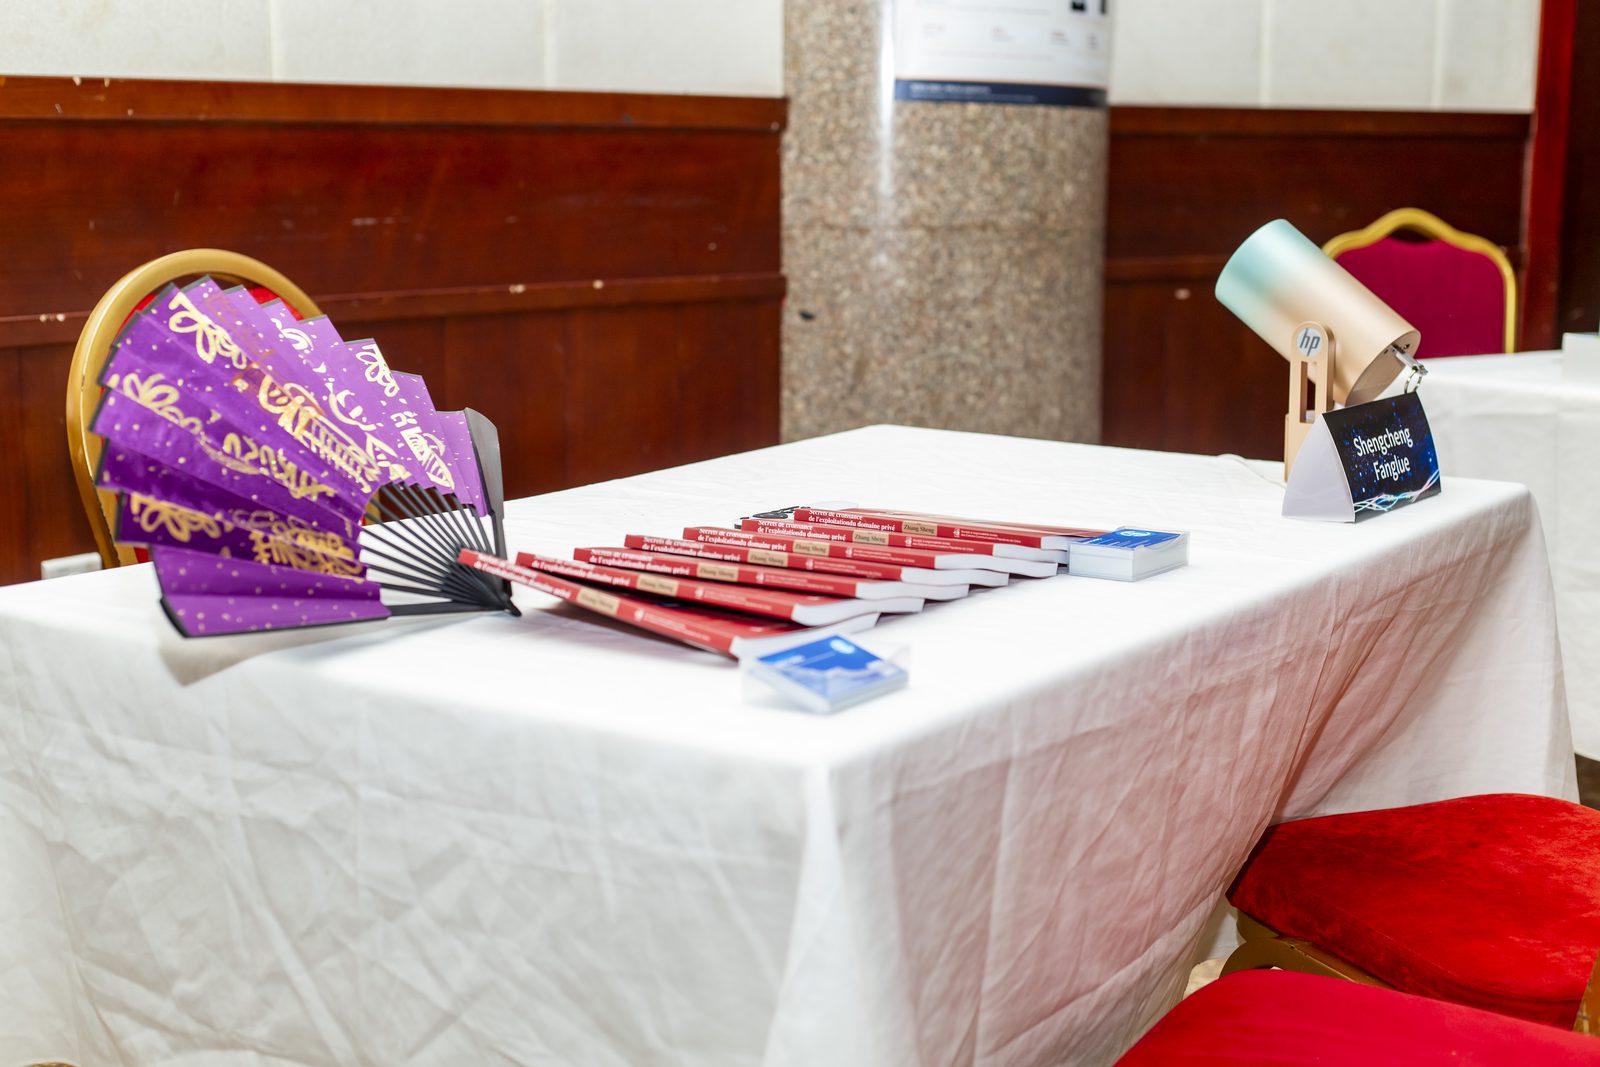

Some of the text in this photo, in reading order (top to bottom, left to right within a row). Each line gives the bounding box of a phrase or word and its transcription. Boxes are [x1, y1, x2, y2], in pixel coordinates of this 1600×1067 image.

[1300, 328, 1320, 356] hp
[1353, 428, 1413, 456] Shengcheng
[816, 516, 856, 526] l'exploitationdu
[857, 520, 880, 529] domaine
[807, 530, 830, 538] domaine
[854, 533, 870, 541] Zhang
[748, 539, 770, 548] domaine
